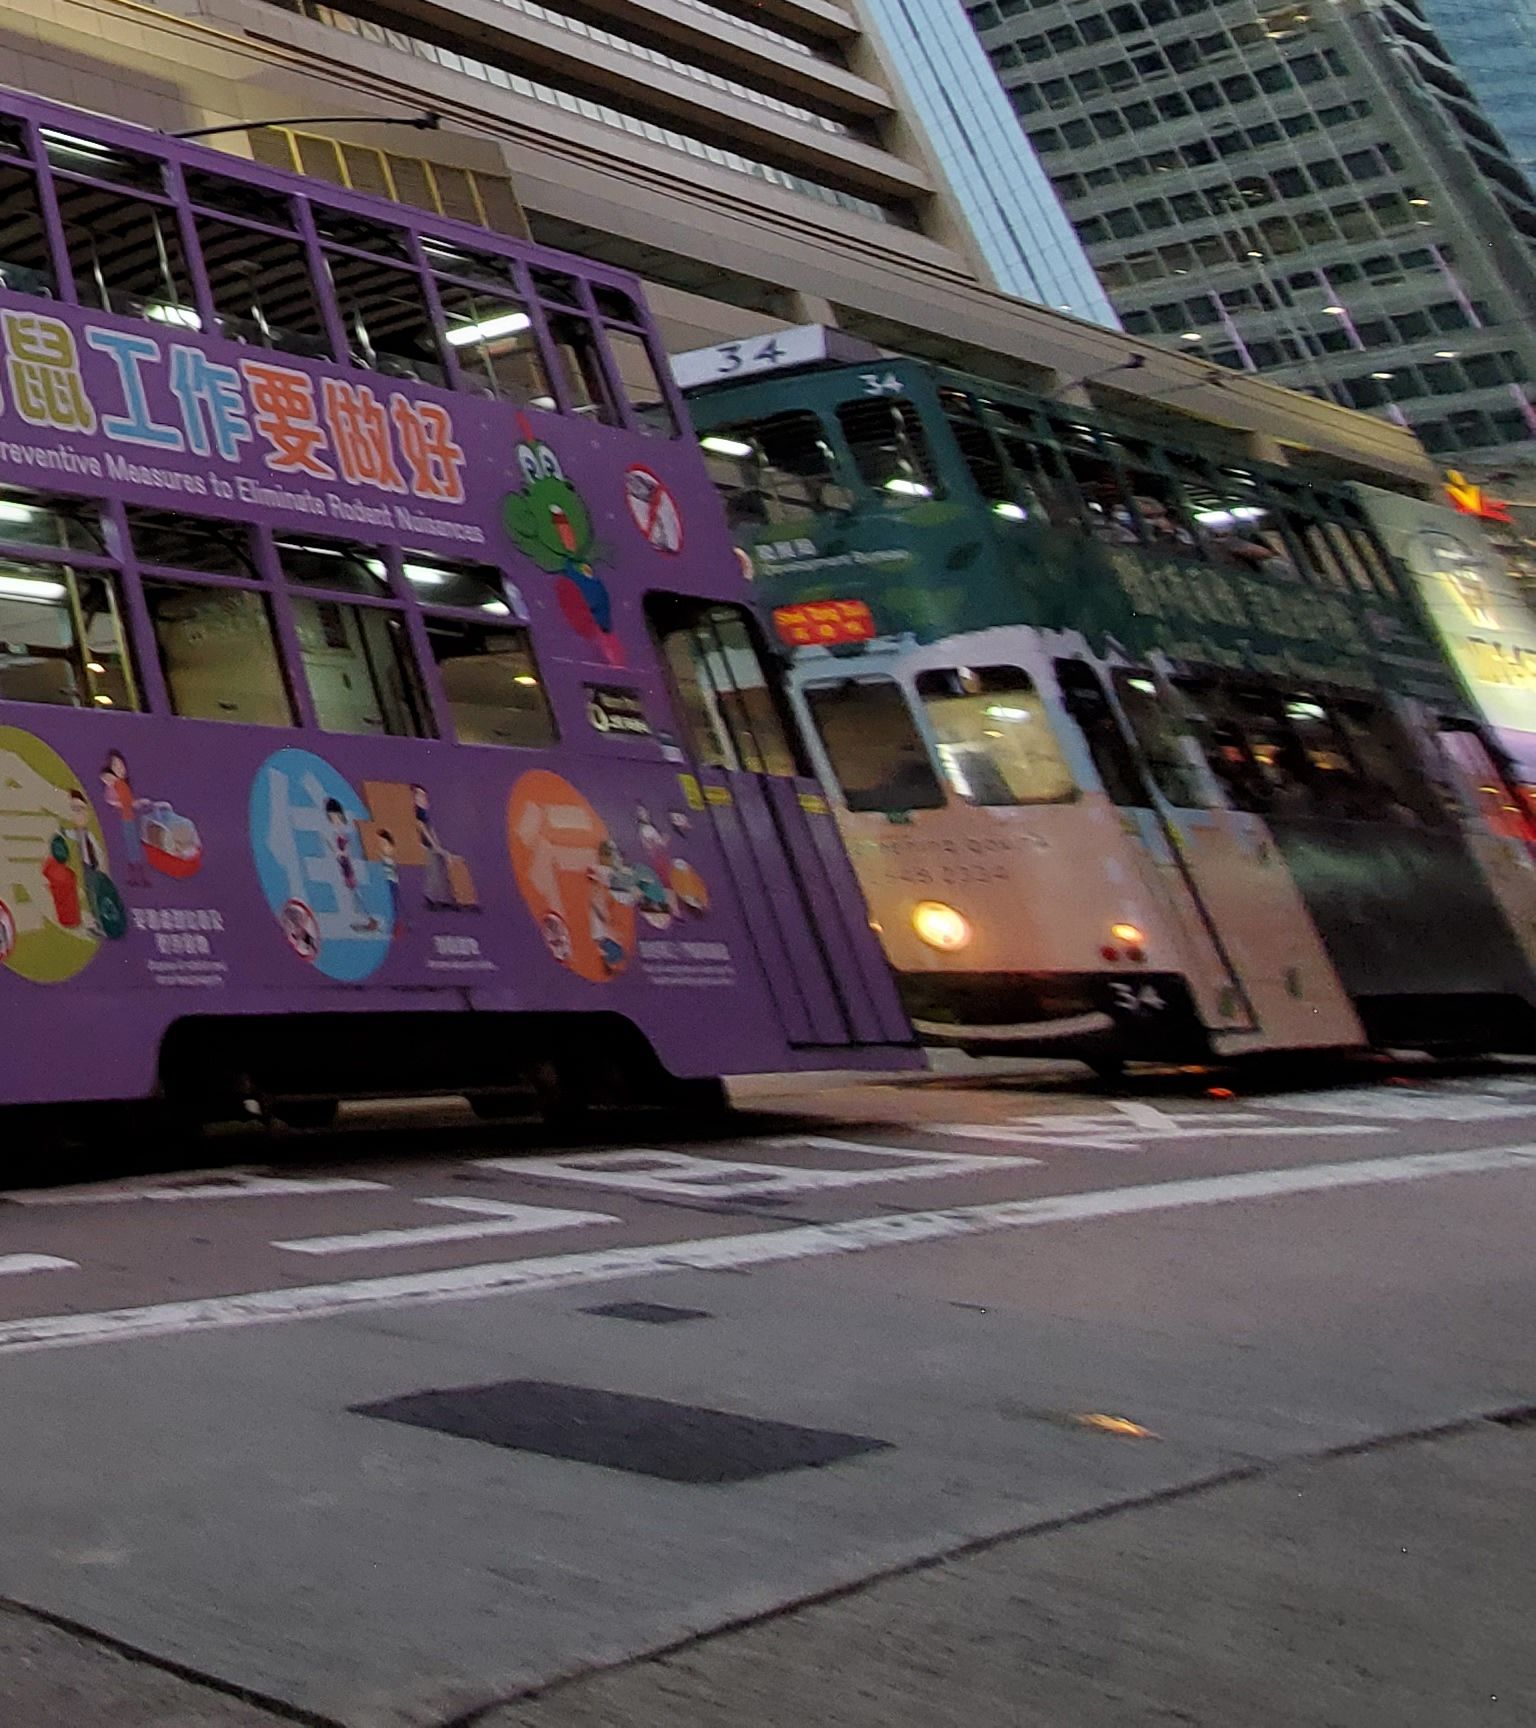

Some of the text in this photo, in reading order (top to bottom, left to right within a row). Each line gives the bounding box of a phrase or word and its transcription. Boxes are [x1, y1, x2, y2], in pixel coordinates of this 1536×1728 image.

[715, 337, 787, 375] 34
[857, 372, 906, 397] 34
[103, 452, 208, 496] Measures
[209, 471, 234, 501] to
[234, 475, 328, 517] Eliminate
[326, 492, 395, 529] Rodent
